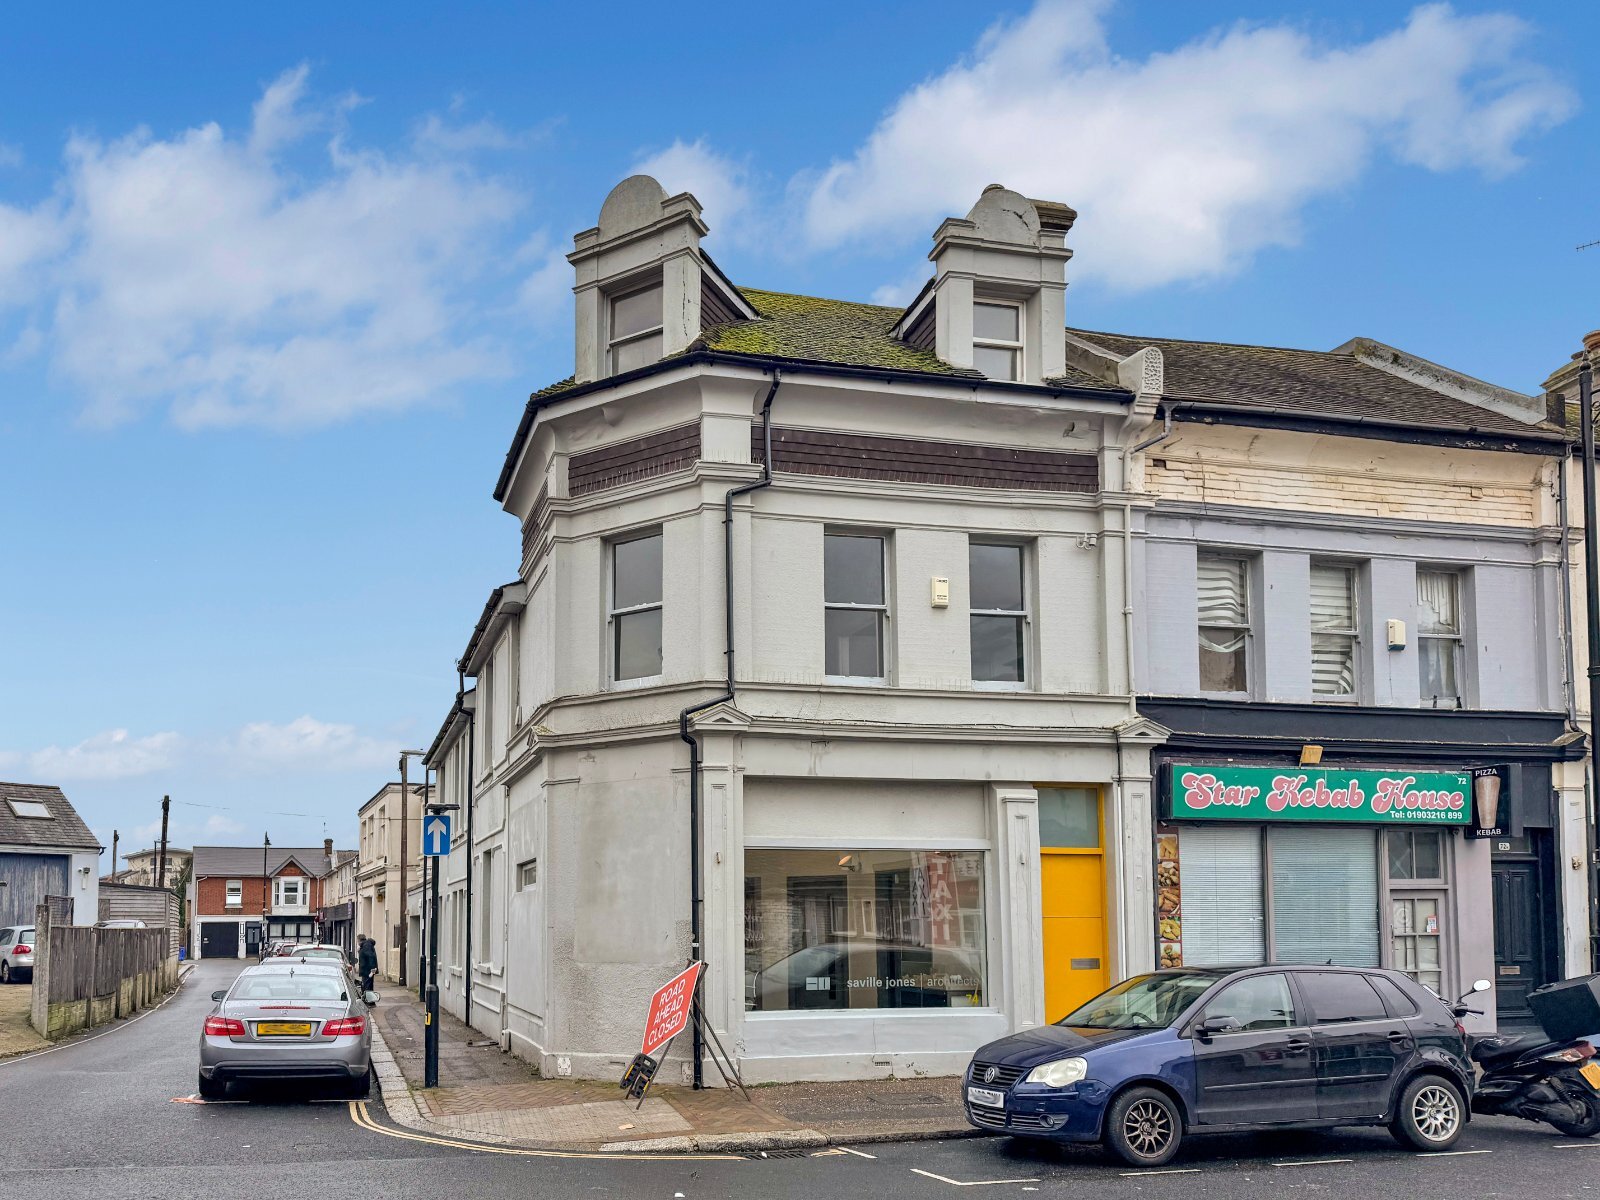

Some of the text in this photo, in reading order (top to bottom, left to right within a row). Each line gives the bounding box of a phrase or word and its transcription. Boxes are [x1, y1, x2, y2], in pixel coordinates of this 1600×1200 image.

[1475, 768, 1498, 776] PIZZA
[1457, 777, 1467, 785] 72
[1181, 772, 1465, 813] Star Kebab House
[1390, 810, 1463, 819] Tel: 01903216 899
[1476, 828, 1502, 836] KEBAB
[846, 976, 883, 988] saville
[885, 976, 916, 990] jones
[658, 978, 686, 1007] ROAD
[653, 994, 684, 1027] AHEAD
[648, 1011, 683, 1046] CLOSED
